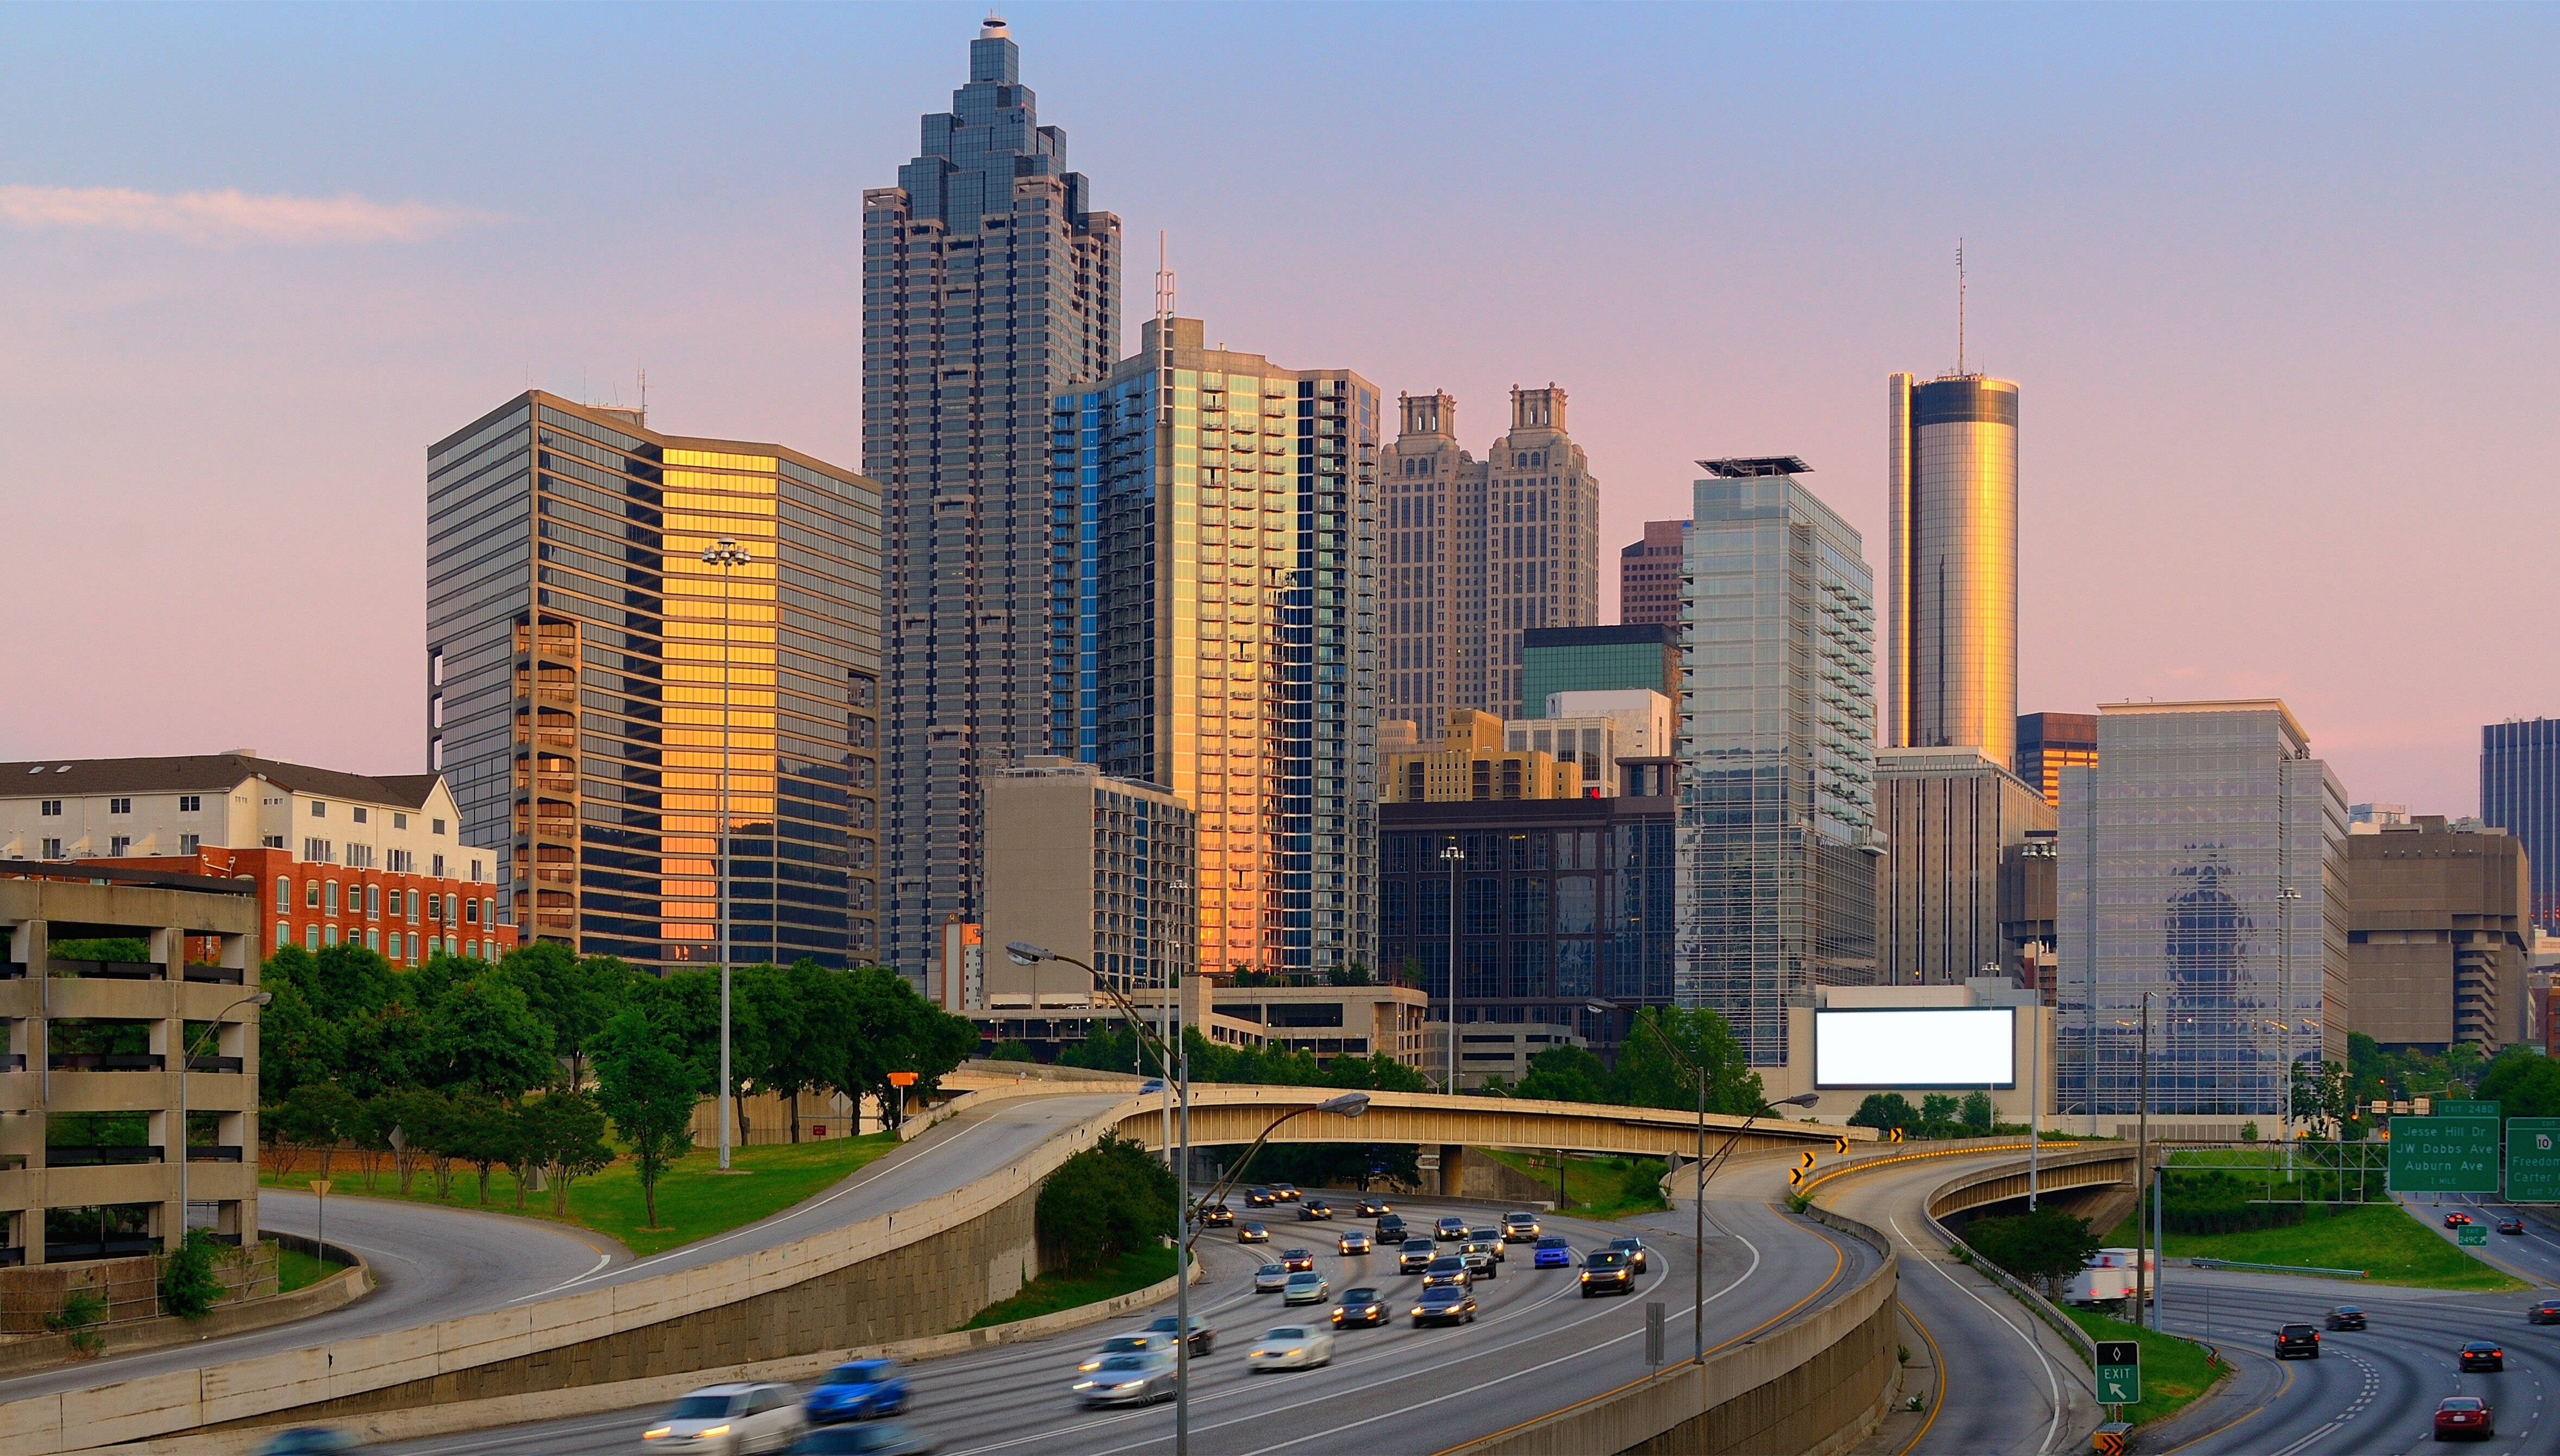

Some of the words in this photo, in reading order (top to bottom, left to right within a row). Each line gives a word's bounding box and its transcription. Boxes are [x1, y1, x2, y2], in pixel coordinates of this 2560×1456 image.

[2403, 1126, 2437, 1137] Jesse
[2445, 1126, 2464, 1137] Hill
[2472, 1126, 2486, 1137] Dr
[2396, 1143, 2416, 1154] JW
[2423, 1143, 2462, 1154] Dobbs
[2470, 1144, 2493, 1154] Ave
[2538, 1139, 2549, 1148] 10
[2405, 1161, 2452, 1170] Auburn
[2460, 1161, 2483, 1170] Ave
[2514, 1172, 2552, 1182] Carter
[2104, 1369, 2131, 1379] EXIT
